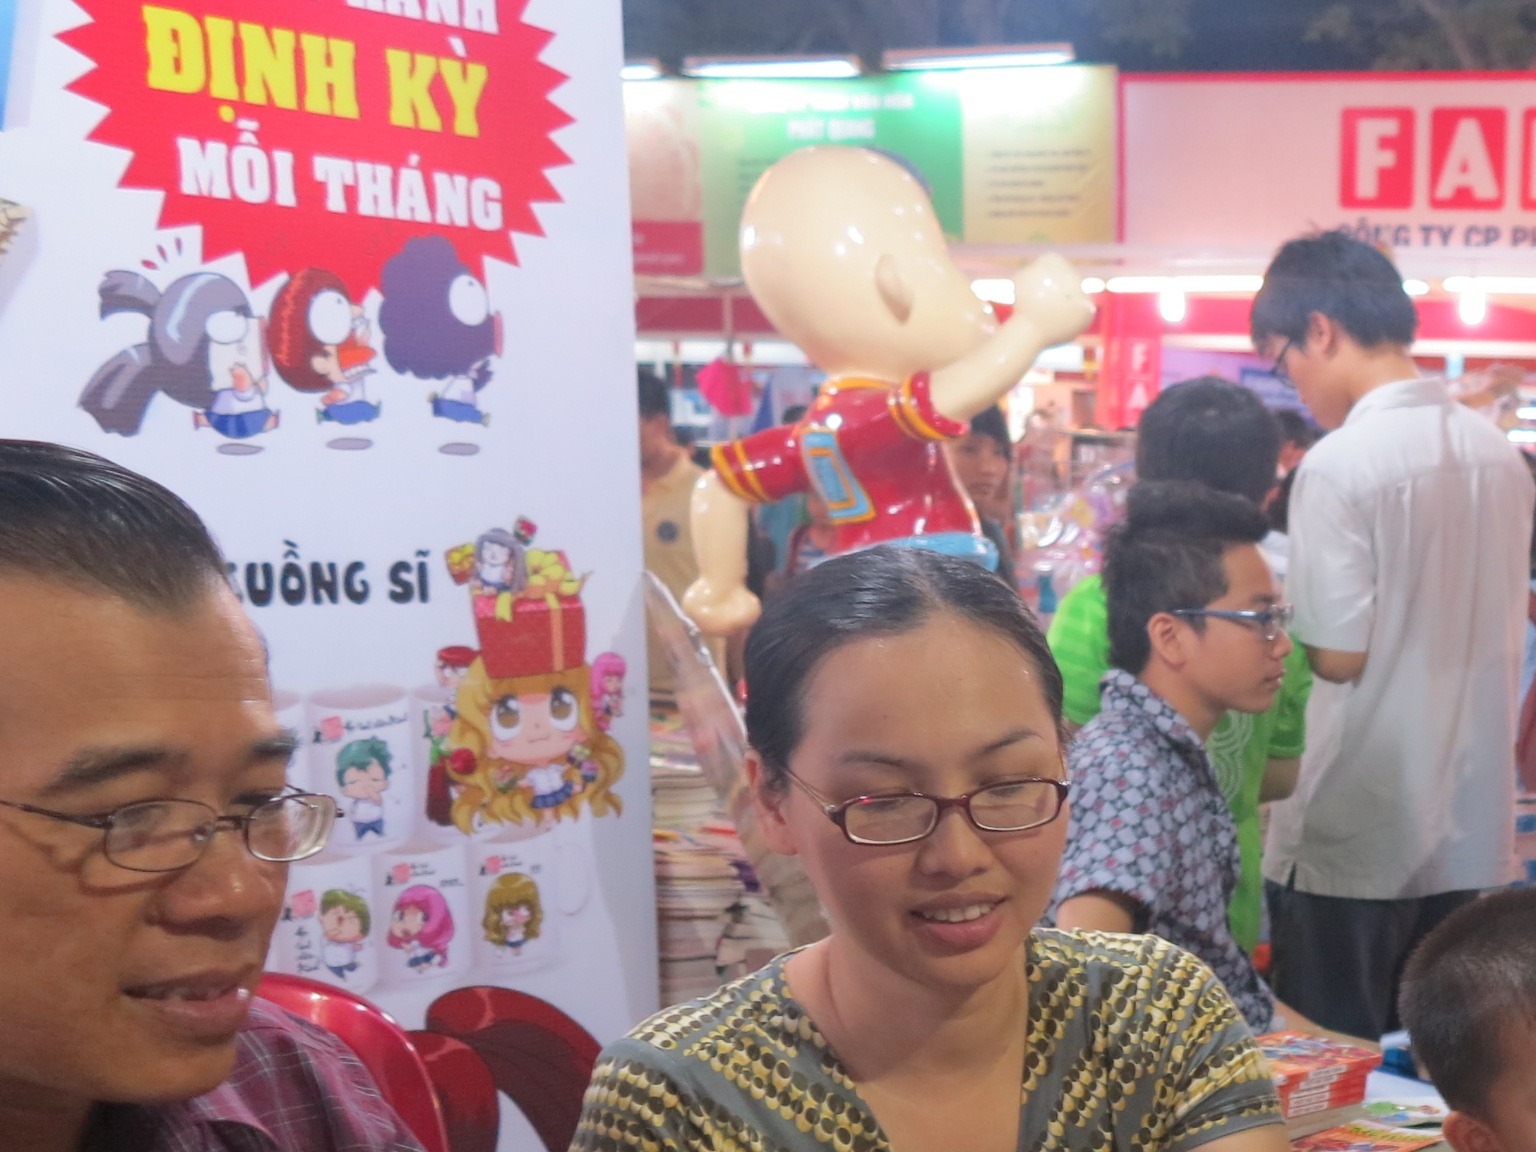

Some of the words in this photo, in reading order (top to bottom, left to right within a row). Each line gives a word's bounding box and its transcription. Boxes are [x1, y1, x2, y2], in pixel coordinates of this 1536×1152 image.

[142, 5, 360, 123] ĐỊNH
[385, 36, 489, 138] KỲ
[176, 118, 297, 208] MỖI
[312, 152, 503, 231] THÁNG
[1418, 223, 1455, 247] TY
[1463, 223, 1501, 248] CP
[388, 549, 431, 604] SĨ
